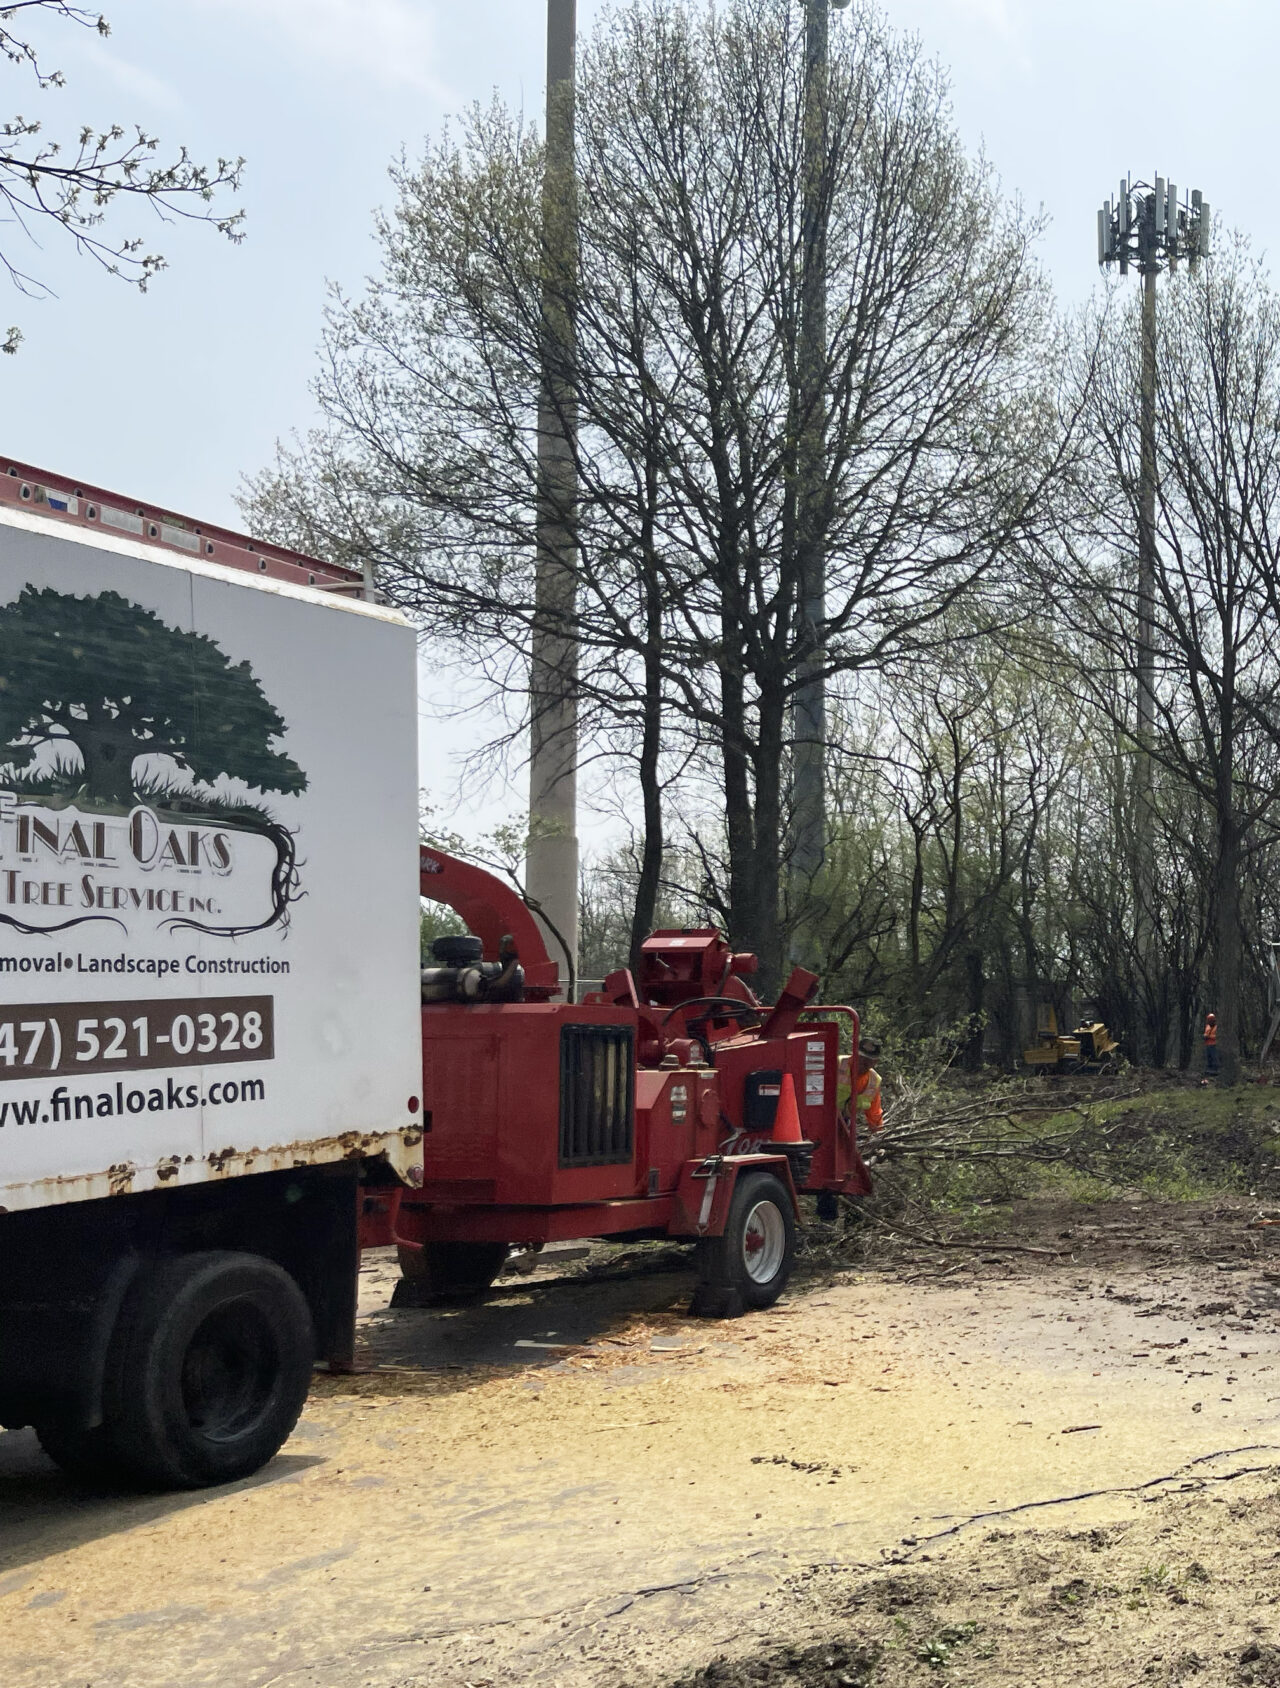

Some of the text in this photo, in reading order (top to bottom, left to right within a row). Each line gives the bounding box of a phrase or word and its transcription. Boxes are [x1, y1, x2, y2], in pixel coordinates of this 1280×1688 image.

[130, 810, 231, 869] OAKS
[2, 870, 73, 906] TREE
[80, 874, 184, 912] SERVICE
[77, 953, 180, 977] Landscape
[185, 956, 290, 974] Construction
[75, 1011, 264, 1062] 521-0328
